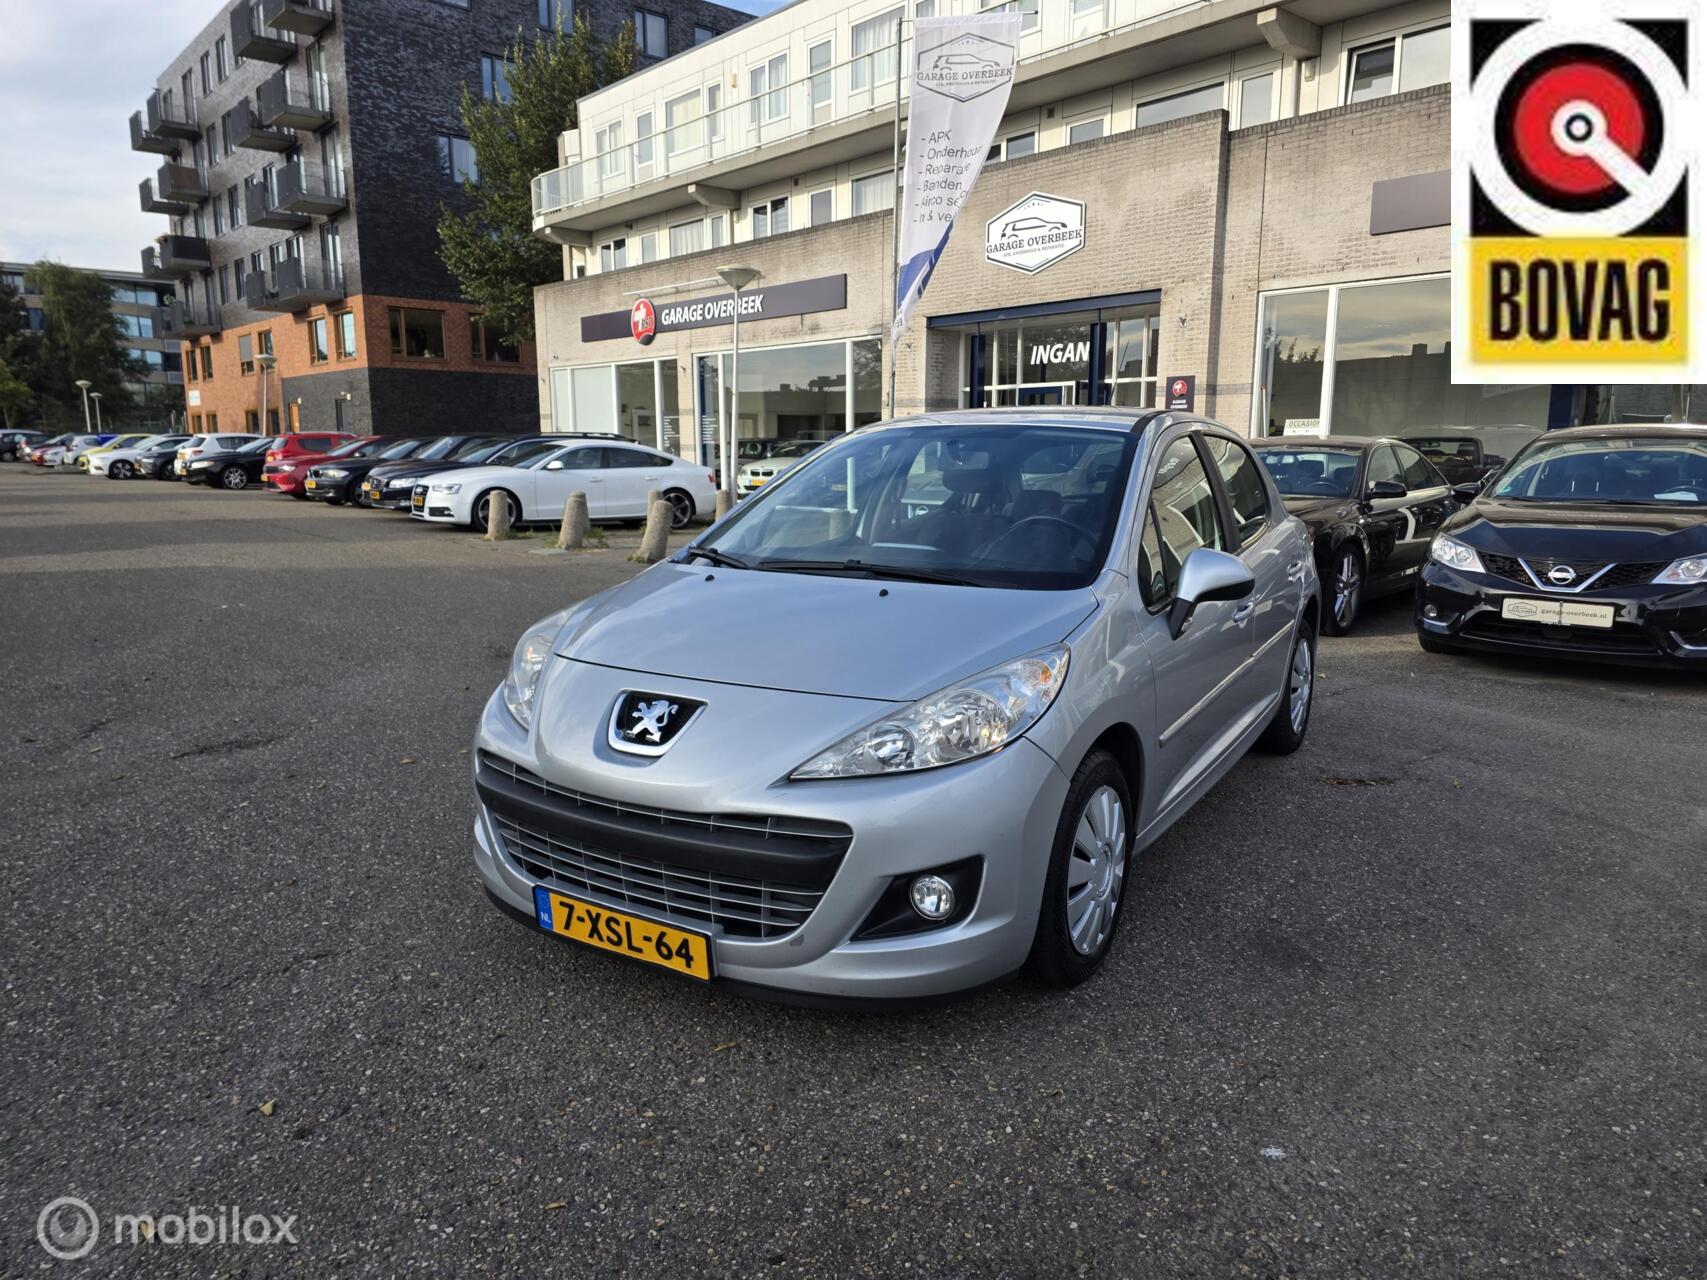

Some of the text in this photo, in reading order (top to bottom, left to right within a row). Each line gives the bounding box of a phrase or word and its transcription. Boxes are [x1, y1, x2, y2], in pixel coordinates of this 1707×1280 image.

[917, 68, 1013, 81] GARAGE OVERBEEK
[928, 129, 952, 143] APK
[986, 239, 1025, 254] GARAGE
[1027, 229, 1083, 247] OVERBEEK
[661, 304, 704, 326] GARAGE
[704, 295, 764, 319] OVERBEEK
[1030, 341, 1091, 365] INGAN
[558, 900, 694, 969] 7-XSL-64
